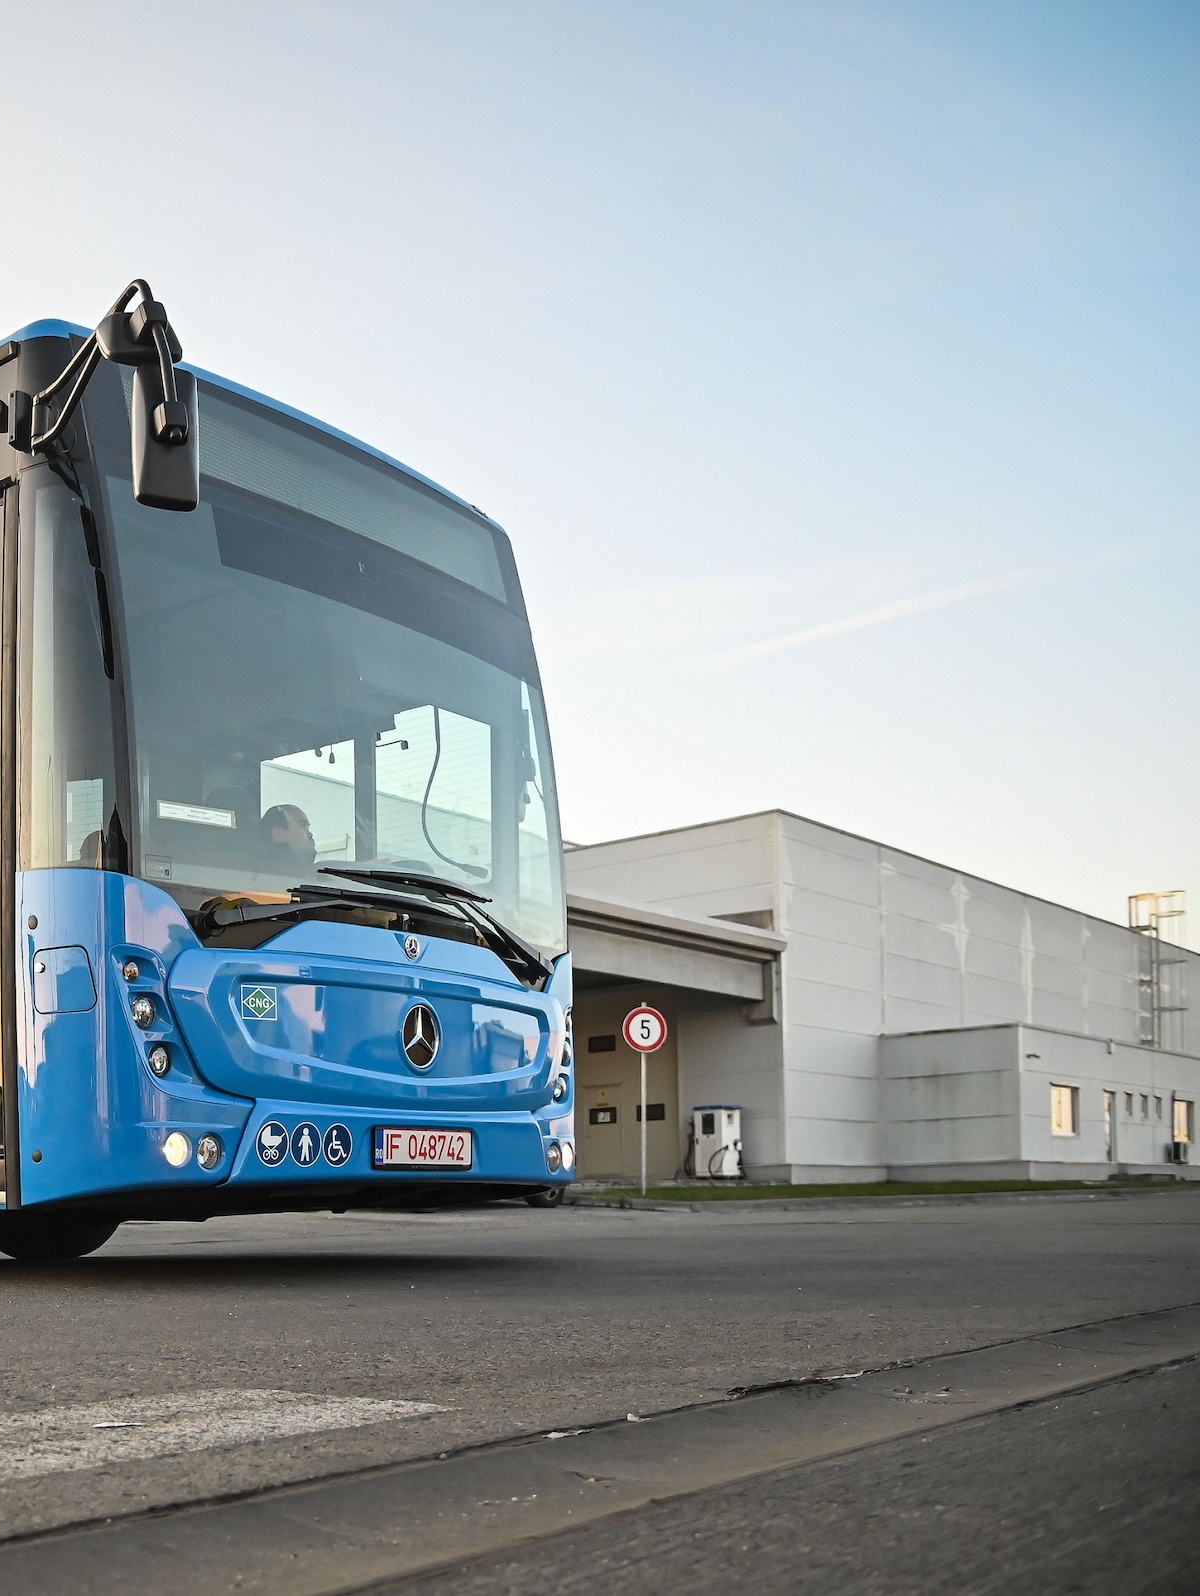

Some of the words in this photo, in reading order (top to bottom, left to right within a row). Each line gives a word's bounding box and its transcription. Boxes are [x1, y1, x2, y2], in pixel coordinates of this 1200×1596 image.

[248, 997, 270, 1009] CNG
[640, 1019, 650, 1040] 5
[386, 1133, 402, 1160] IF
[408, 1134, 465, 1161] 048742
